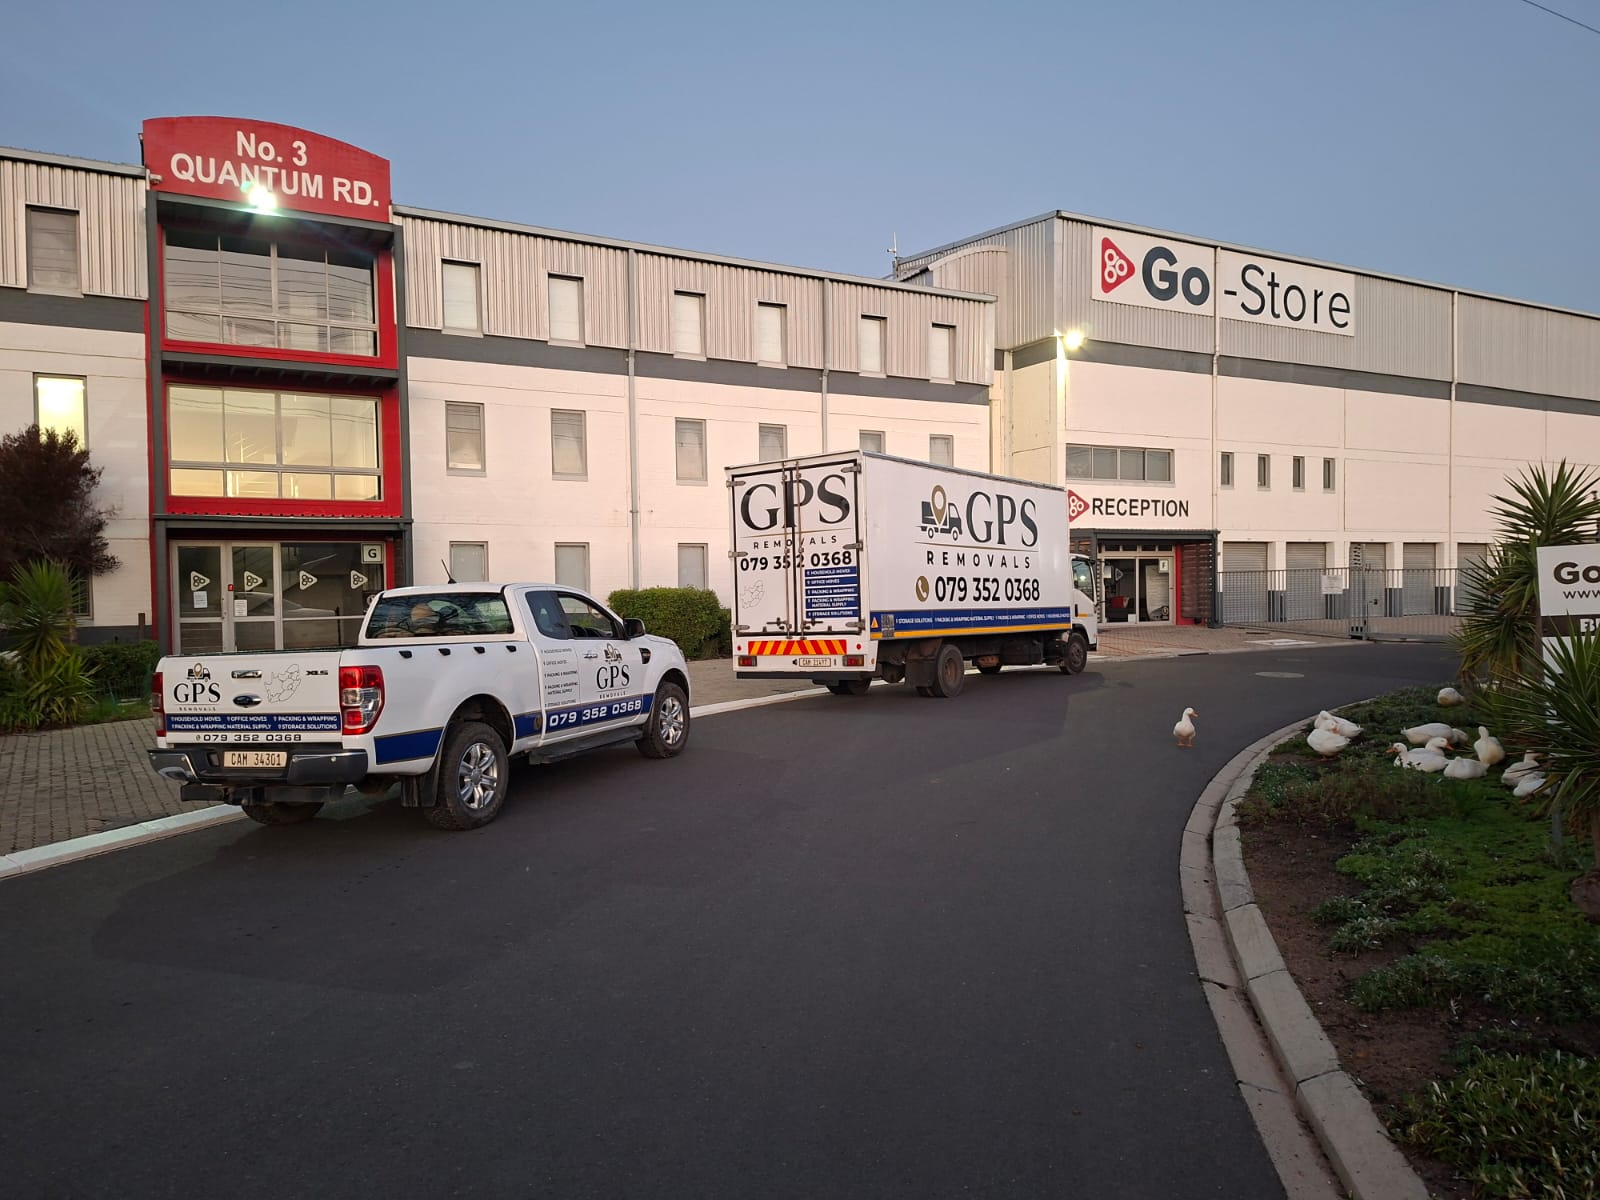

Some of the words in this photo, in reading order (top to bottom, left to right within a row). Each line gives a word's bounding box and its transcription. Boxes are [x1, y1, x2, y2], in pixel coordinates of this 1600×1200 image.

[236, 130, 282, 162] No.
[292, 140, 307, 166] 3
[170, 153, 323, 200] QUANTUM
[333, 177, 380, 206] RD.
[1142, 246, 1210, 306] Go
[740, 474, 850, 530] GPS
[1092, 498, 1189, 518] RECEPTION
[966, 491, 1038, 547] GPS
[368, 548, 377, 558] G
[740, 556, 768, 572] 079
[773, 554, 805, 570] 352
[810, 551, 852, 567] 0368
[926, 550, 1030, 568] REMOVALS
[935, 576, 968, 602] 079
[972, 577, 1000, 602] 352
[1005, 578, 1040, 602] 0368
[597, 664, 630, 689] GPS
[174, 682, 221, 703] GPS
[549, 712, 577, 727] 079
[582, 706, 607, 720] 352
[612, 700, 641, 714] 0368
[254, 753, 281, 766] 34301
